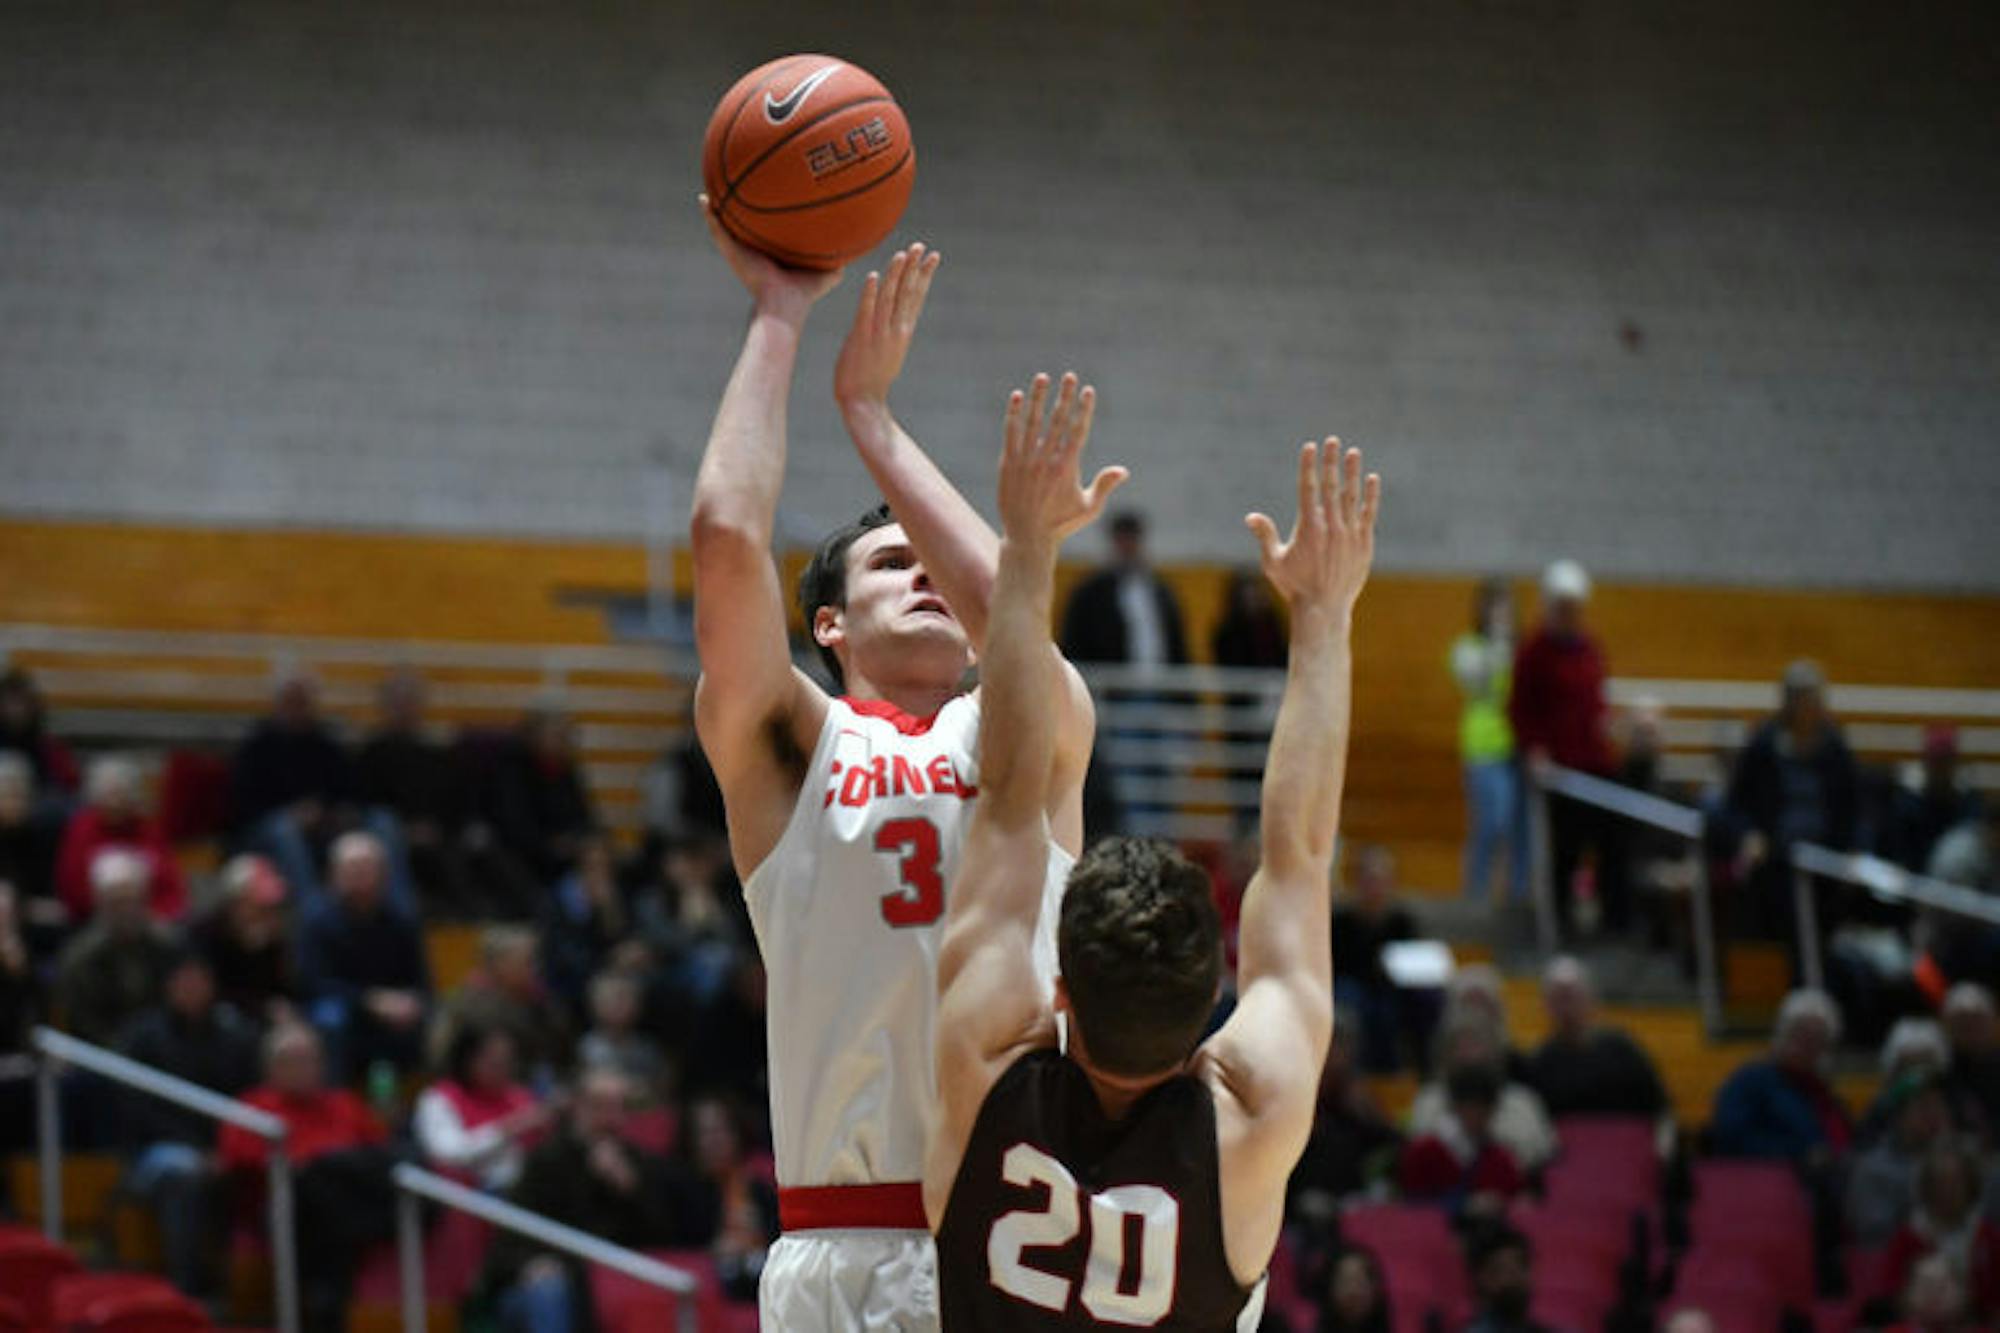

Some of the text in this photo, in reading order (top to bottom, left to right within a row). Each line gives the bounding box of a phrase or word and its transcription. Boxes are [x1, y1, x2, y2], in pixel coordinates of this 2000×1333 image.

[806, 117, 890, 177] ELITE
[874, 816, 945, 928] 3
[987, 1141, 1180, 1327] 20
